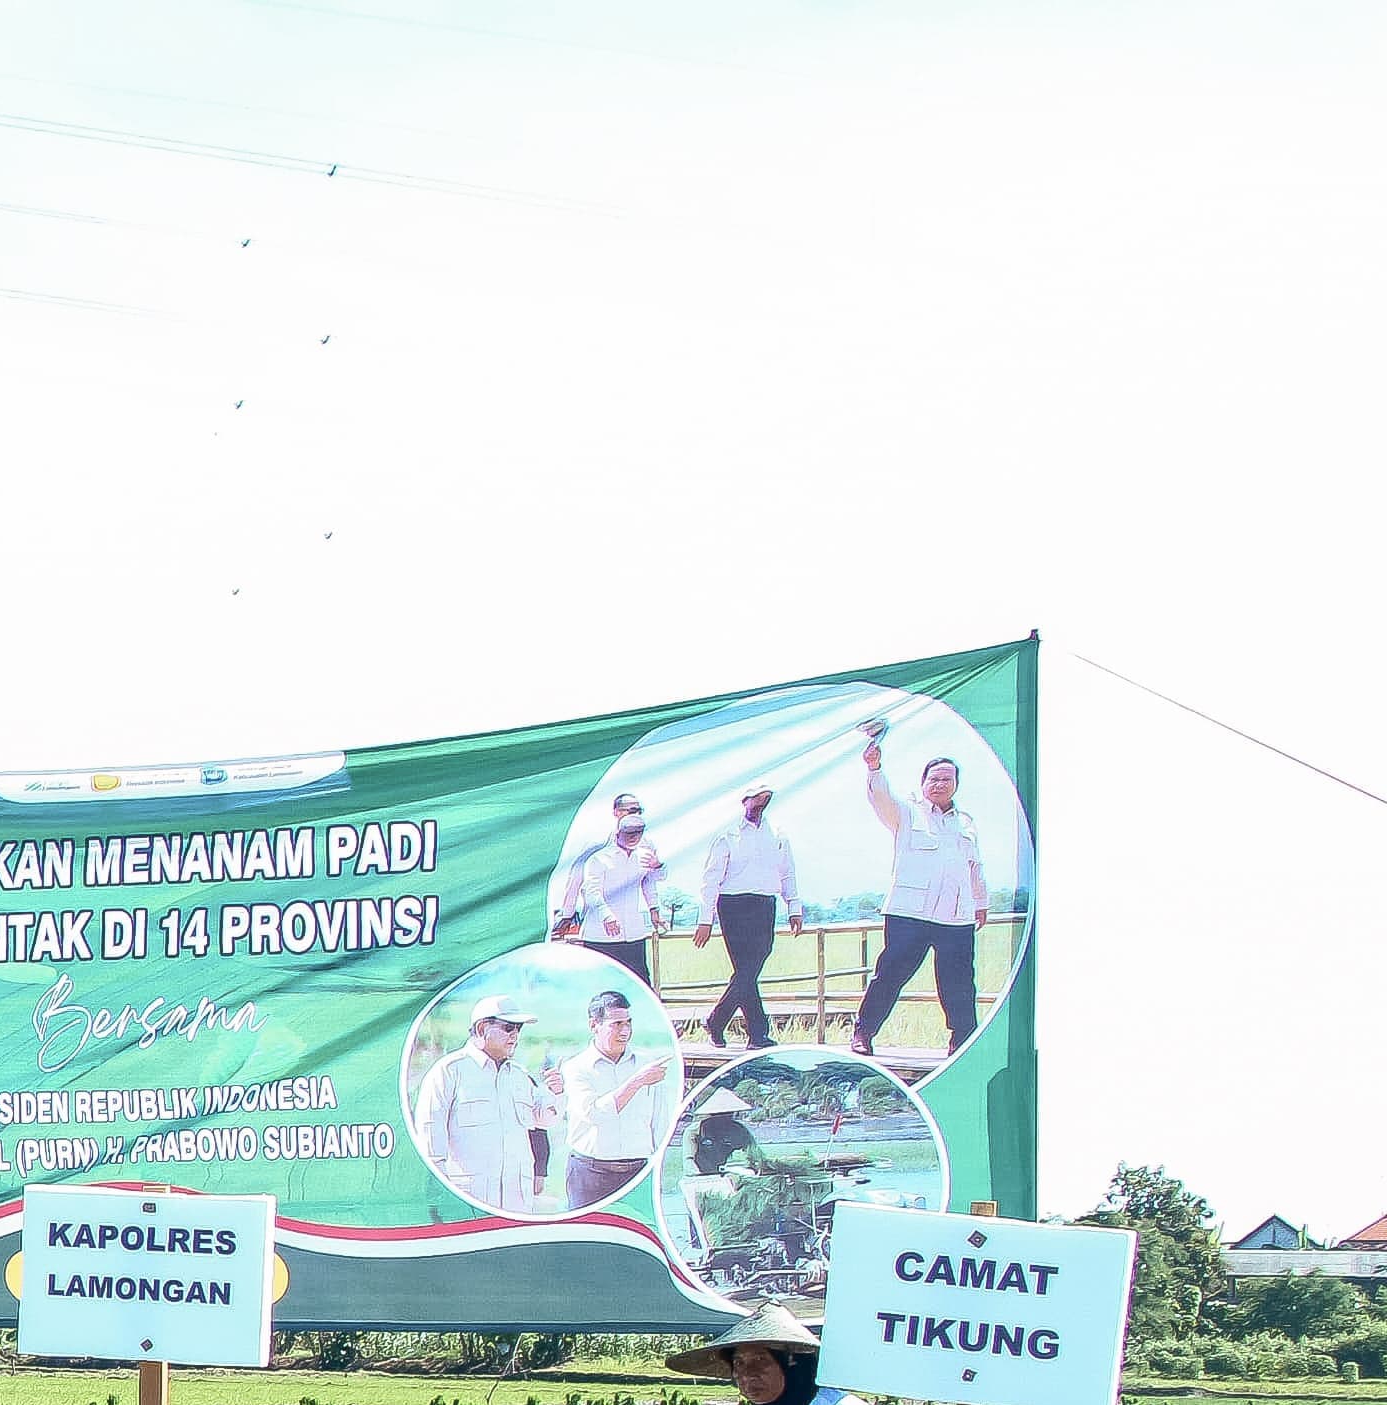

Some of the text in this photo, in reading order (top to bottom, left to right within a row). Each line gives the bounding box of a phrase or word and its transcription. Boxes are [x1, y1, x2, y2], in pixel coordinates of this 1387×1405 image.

[84, 827, 314, 886] MENANAM
[326, 820, 438, 876] PADI
[100, 909, 146, 960] DI
[158, 907, 209, 957] 14
[220, 896, 440, 955] PROVINSI
[32, 973, 269, 1073] Bersama
[74, 1086, 199, 1123] REPUBLIK
[201, 1076, 338, 1116] INDONESIA
[15, 1135, 99, 1178] (PURN)
[102, 1138, 125, 1164] H.
[130, 1127, 258, 1164] PRABOWO
[262, 1122, 396, 1160] SUBIANTO
[48, 1222, 237, 1256] KAPOLRES
[47, 1273, 232, 1306] LAMONGAN
[894, 1251, 1060, 1296] CAMAT
[876, 1311, 1060, 1361] TIKUNG
